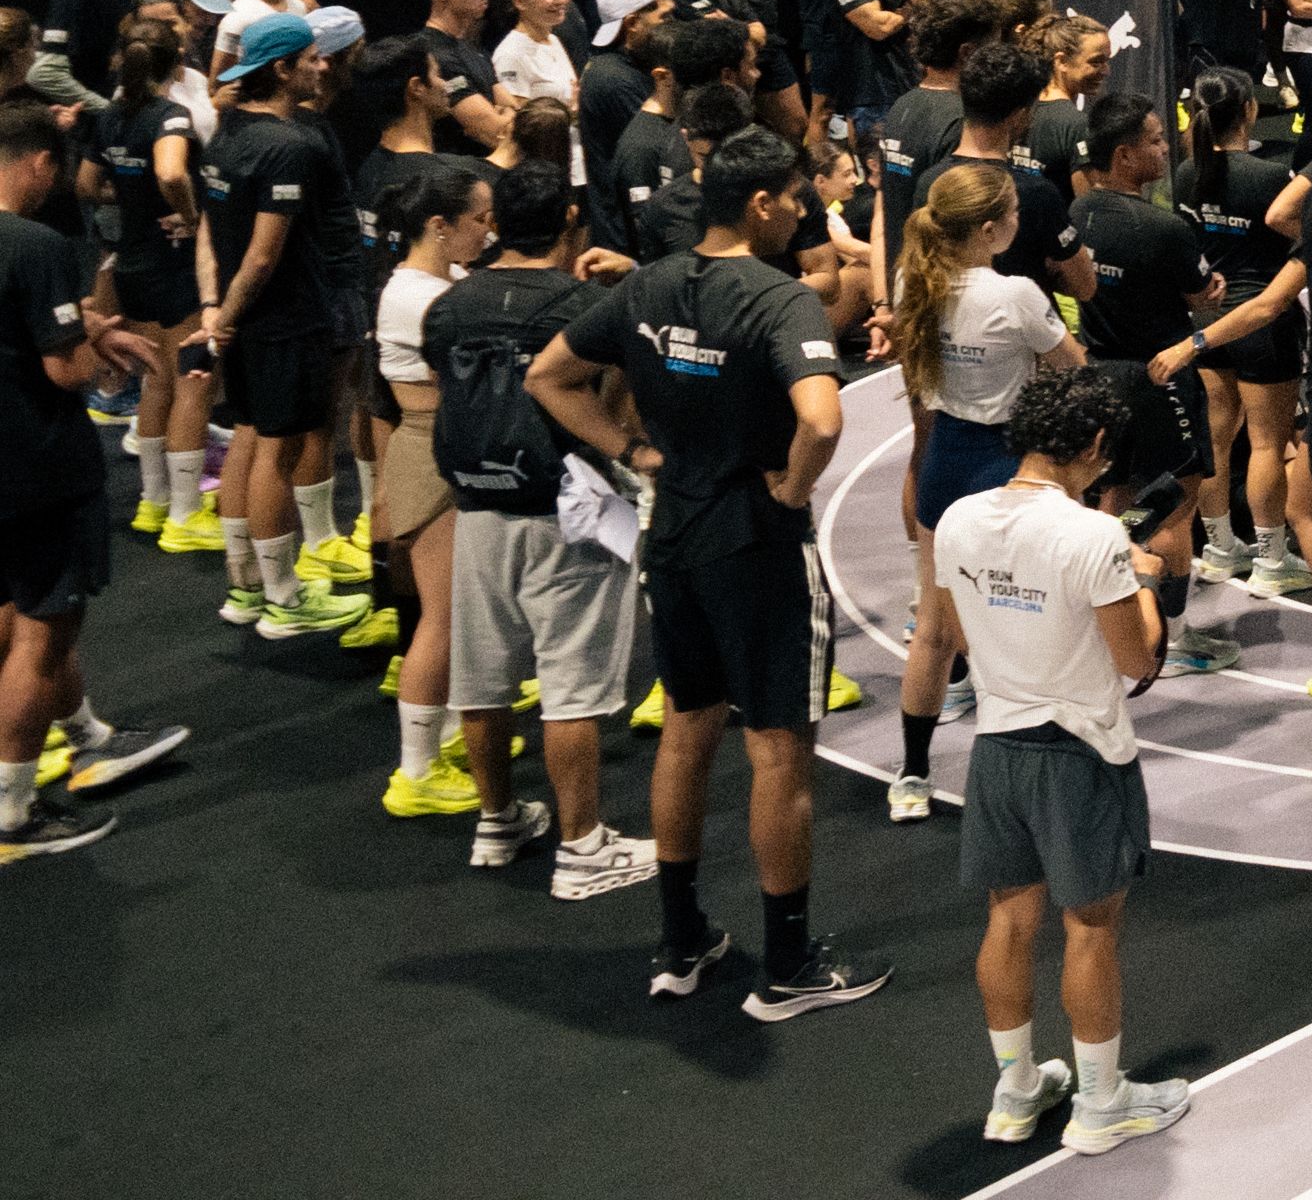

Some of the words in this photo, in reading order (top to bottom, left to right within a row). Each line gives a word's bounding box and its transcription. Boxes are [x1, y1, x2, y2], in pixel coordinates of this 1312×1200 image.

[1228, 216, 1252, 229] CITY
[1100, 264, 1125, 278] CITY
[697, 348, 727, 366] CITY
[960, 346, 986, 356] CITY
[987, 569, 1013, 584] RUN
[989, 584, 1020, 599] YOUR
[1022, 588, 1047, 604] CITY
